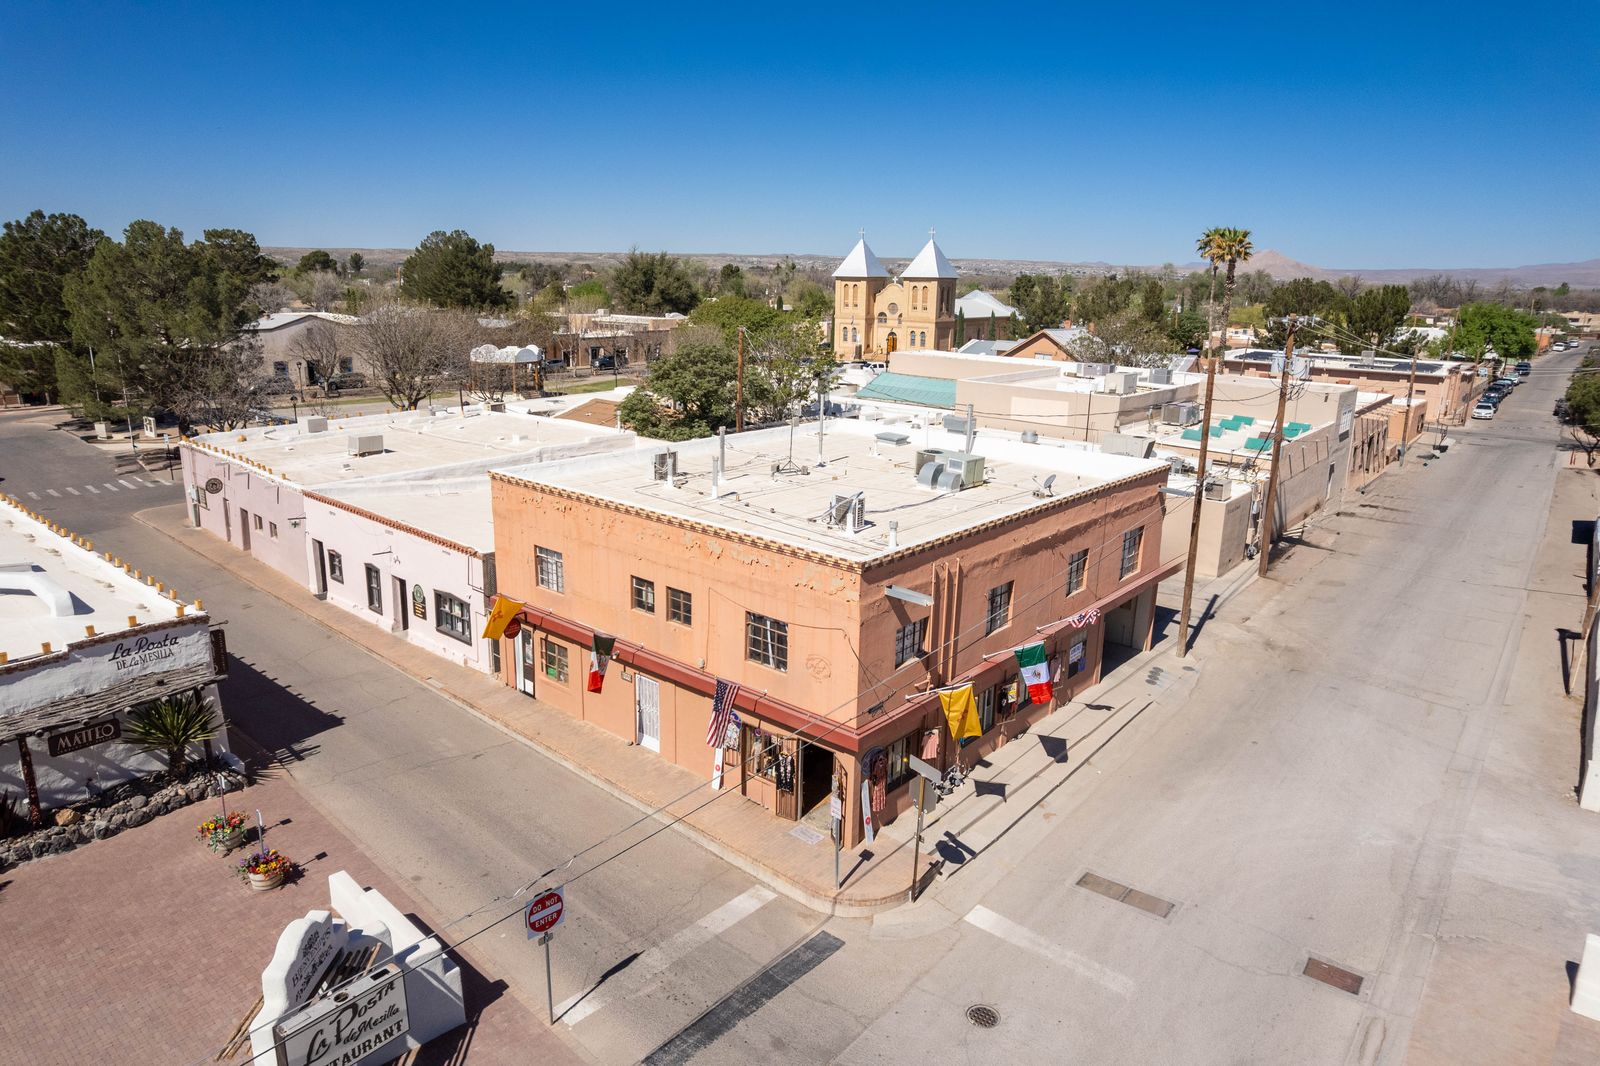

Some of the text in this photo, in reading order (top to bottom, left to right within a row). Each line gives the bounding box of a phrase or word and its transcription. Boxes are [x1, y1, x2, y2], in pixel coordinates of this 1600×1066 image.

[108, 633, 179, 662] La Posta
[116, 659, 129, 671] DE
[139, 647, 174, 664] MESILLA
[532, 896, 558, 913] DO NOT
[535, 912, 557, 928] ENTER
